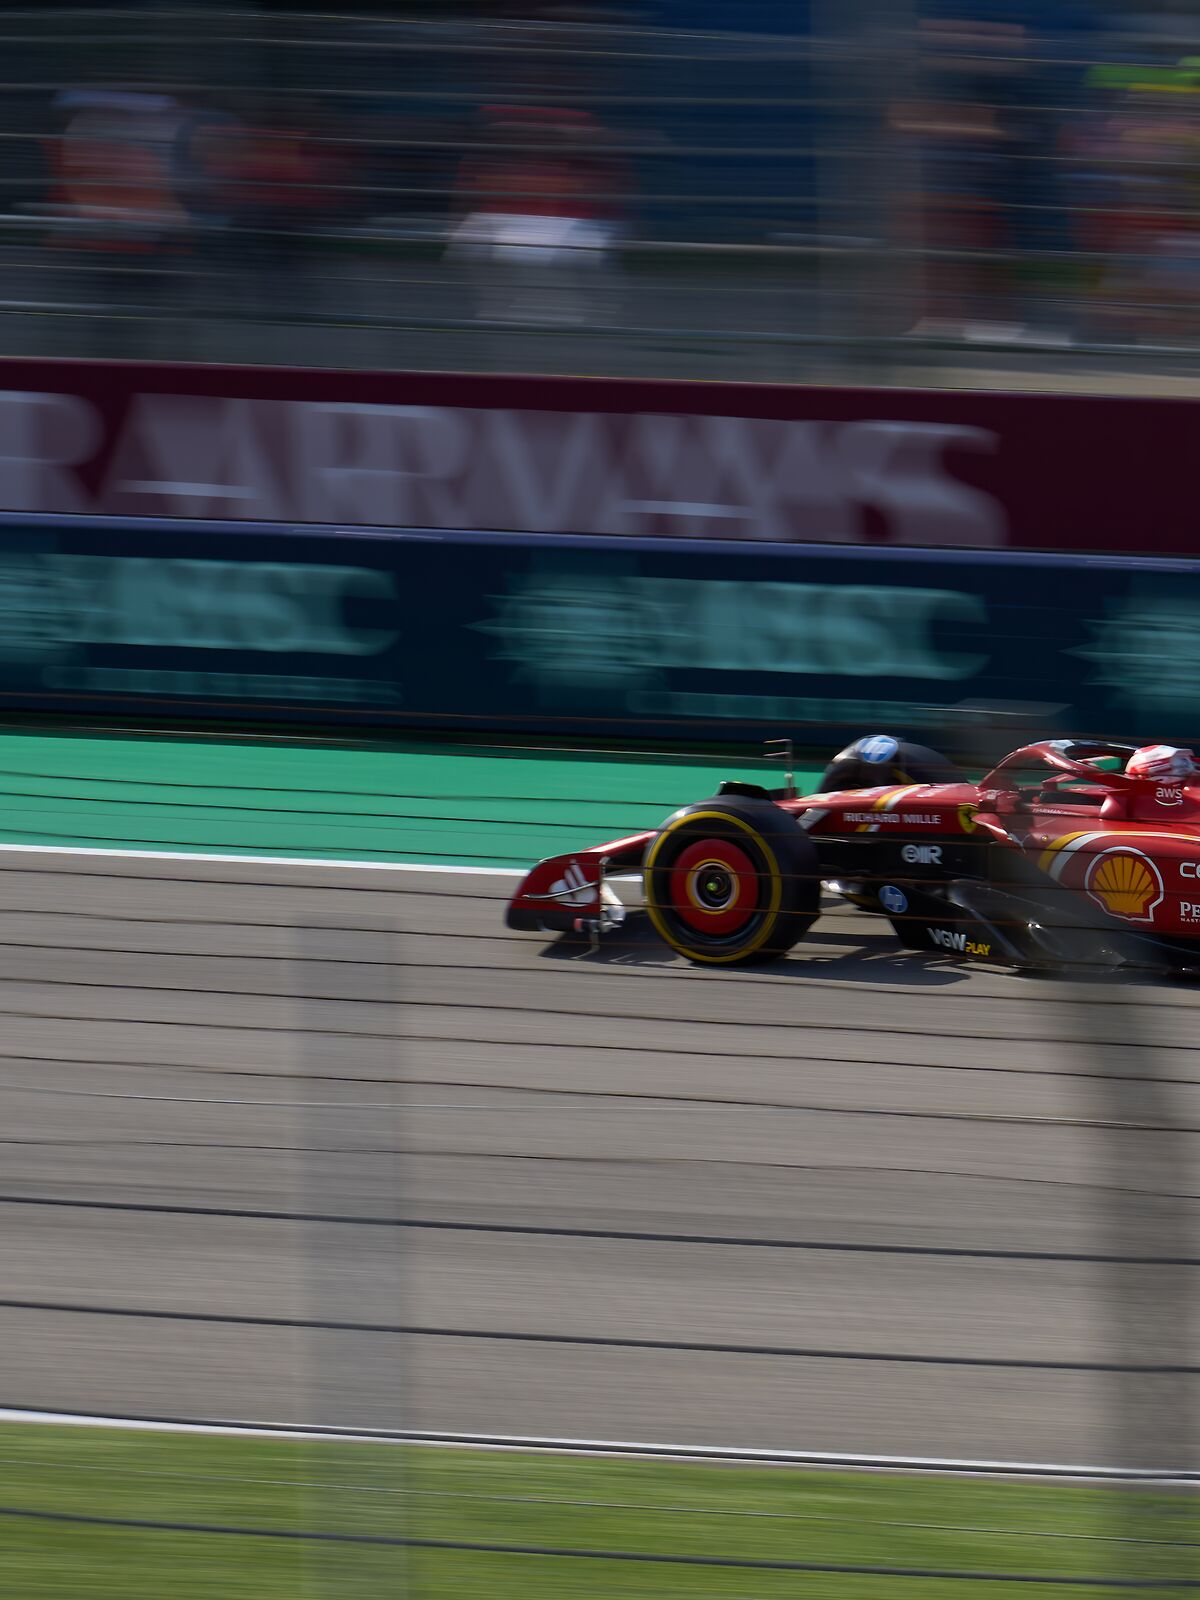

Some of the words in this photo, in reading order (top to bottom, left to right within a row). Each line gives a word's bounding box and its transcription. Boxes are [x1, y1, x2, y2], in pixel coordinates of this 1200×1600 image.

[1155, 787, 1183, 799] aws
[843, 812, 900, 823] RICHARD
[902, 814, 942, 824] MILLE
